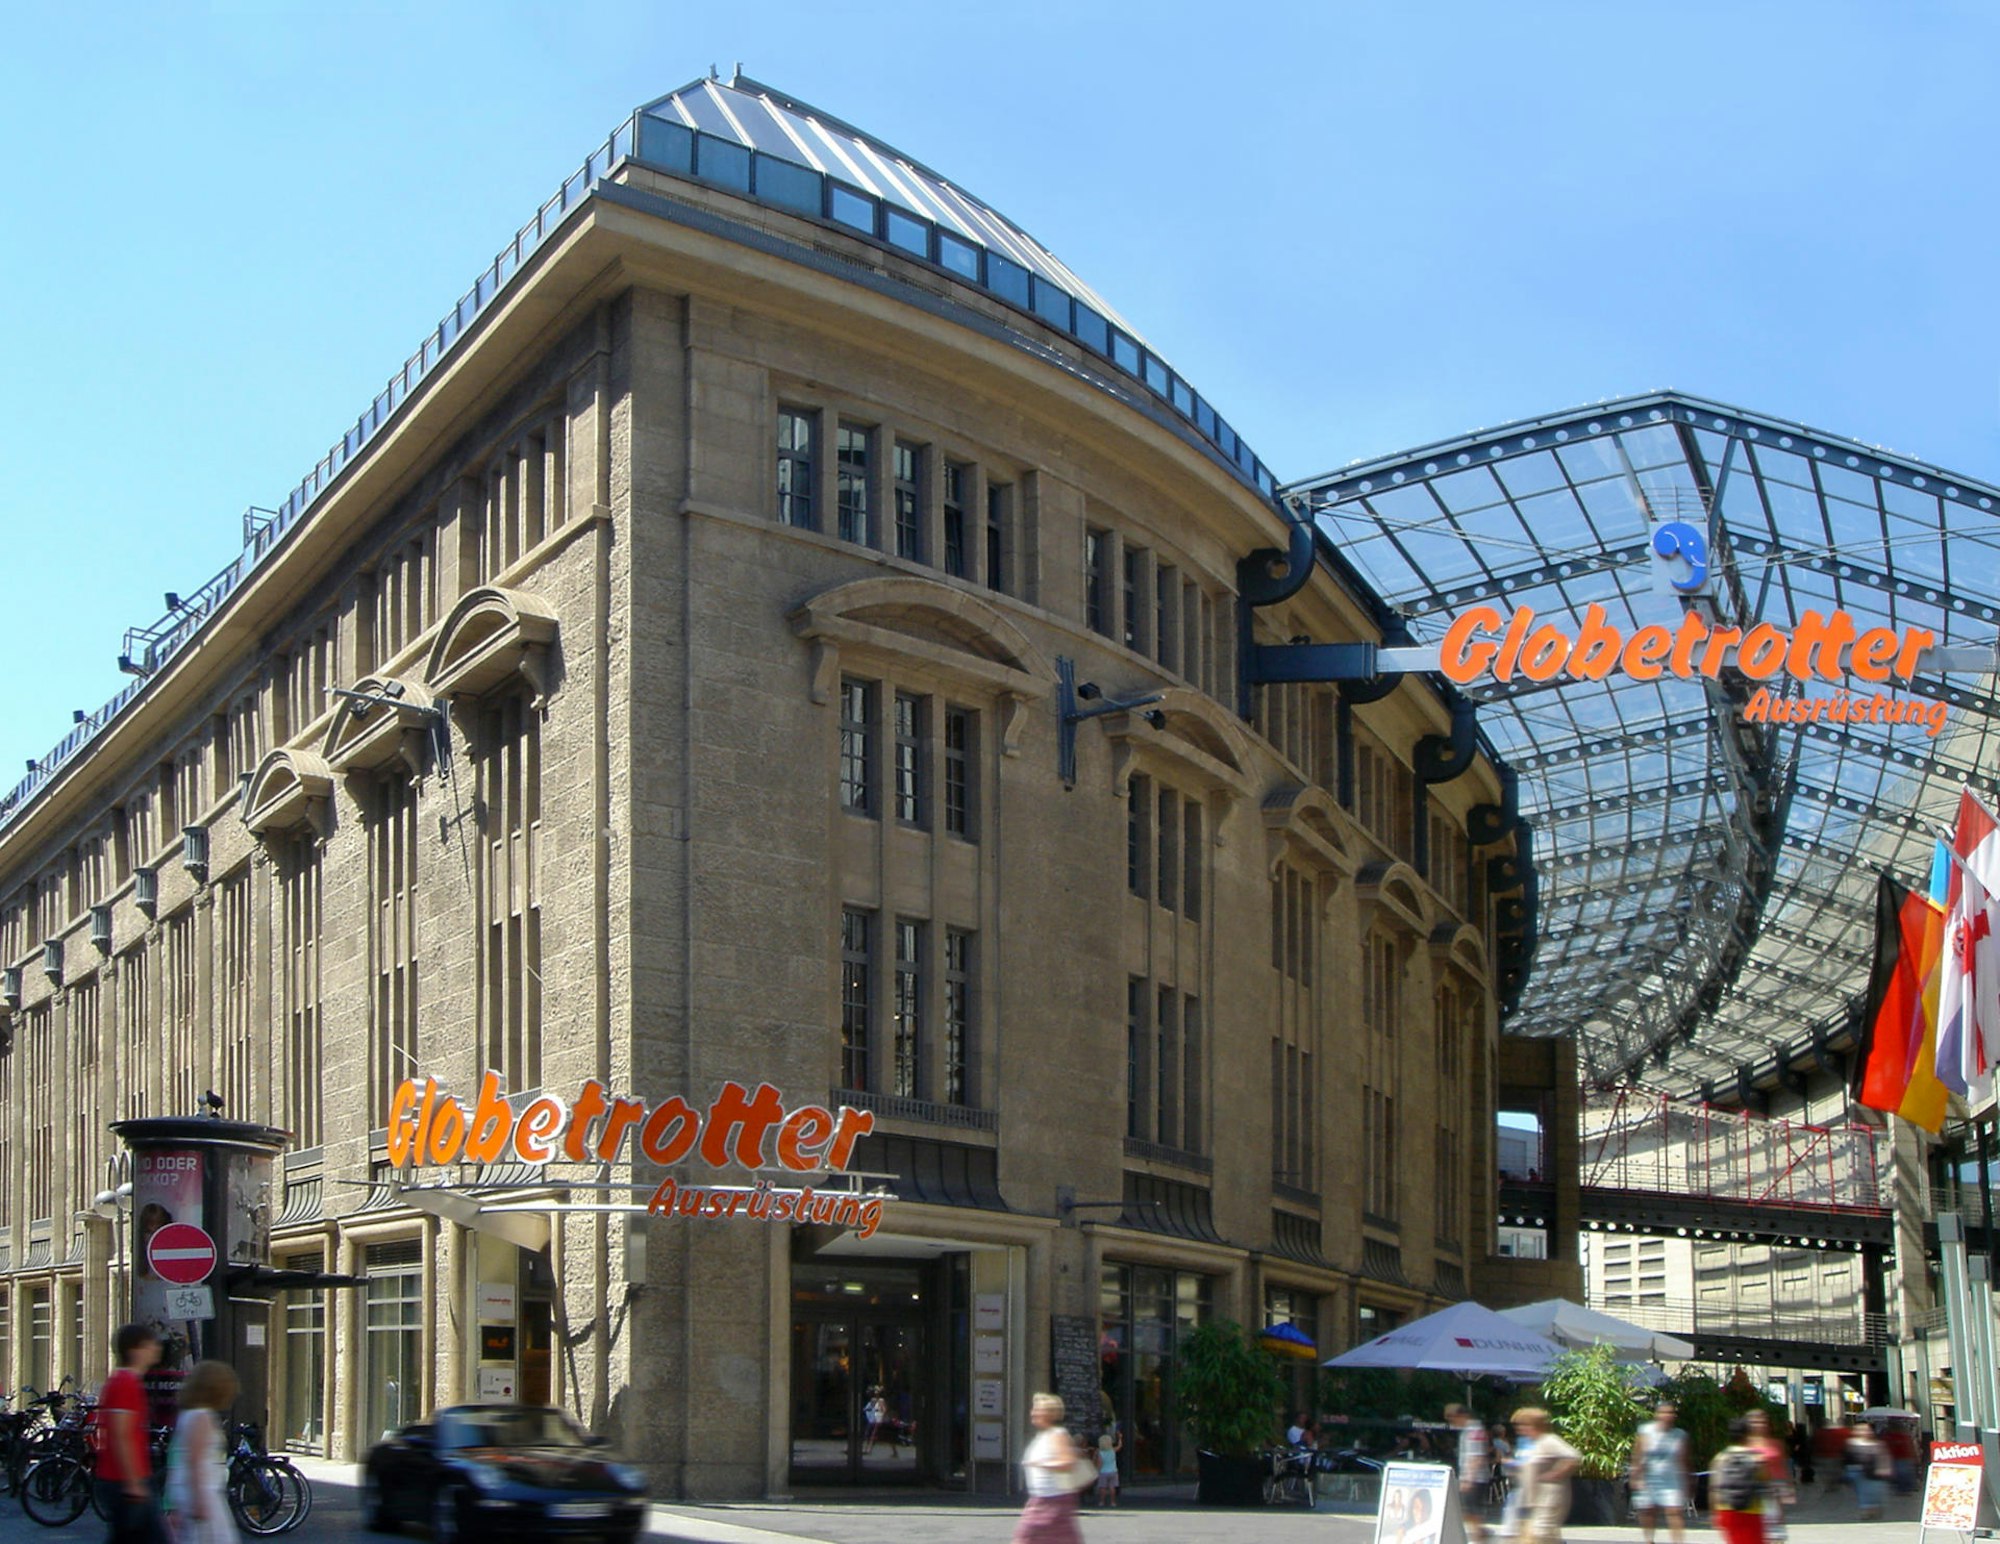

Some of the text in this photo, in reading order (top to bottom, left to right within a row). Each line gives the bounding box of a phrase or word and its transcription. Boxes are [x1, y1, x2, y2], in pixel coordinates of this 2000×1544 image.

[1440, 602, 1934, 684] Globetrotter
[1744, 688, 1948, 738] Ausrüstung
[387, 1069, 875, 1172] Globetrotter
[156, 1156, 197, 1171] ODER
[648, 1176, 883, 1239] Ausrüstung
[1934, 1444, 1979, 1461] Aktion
